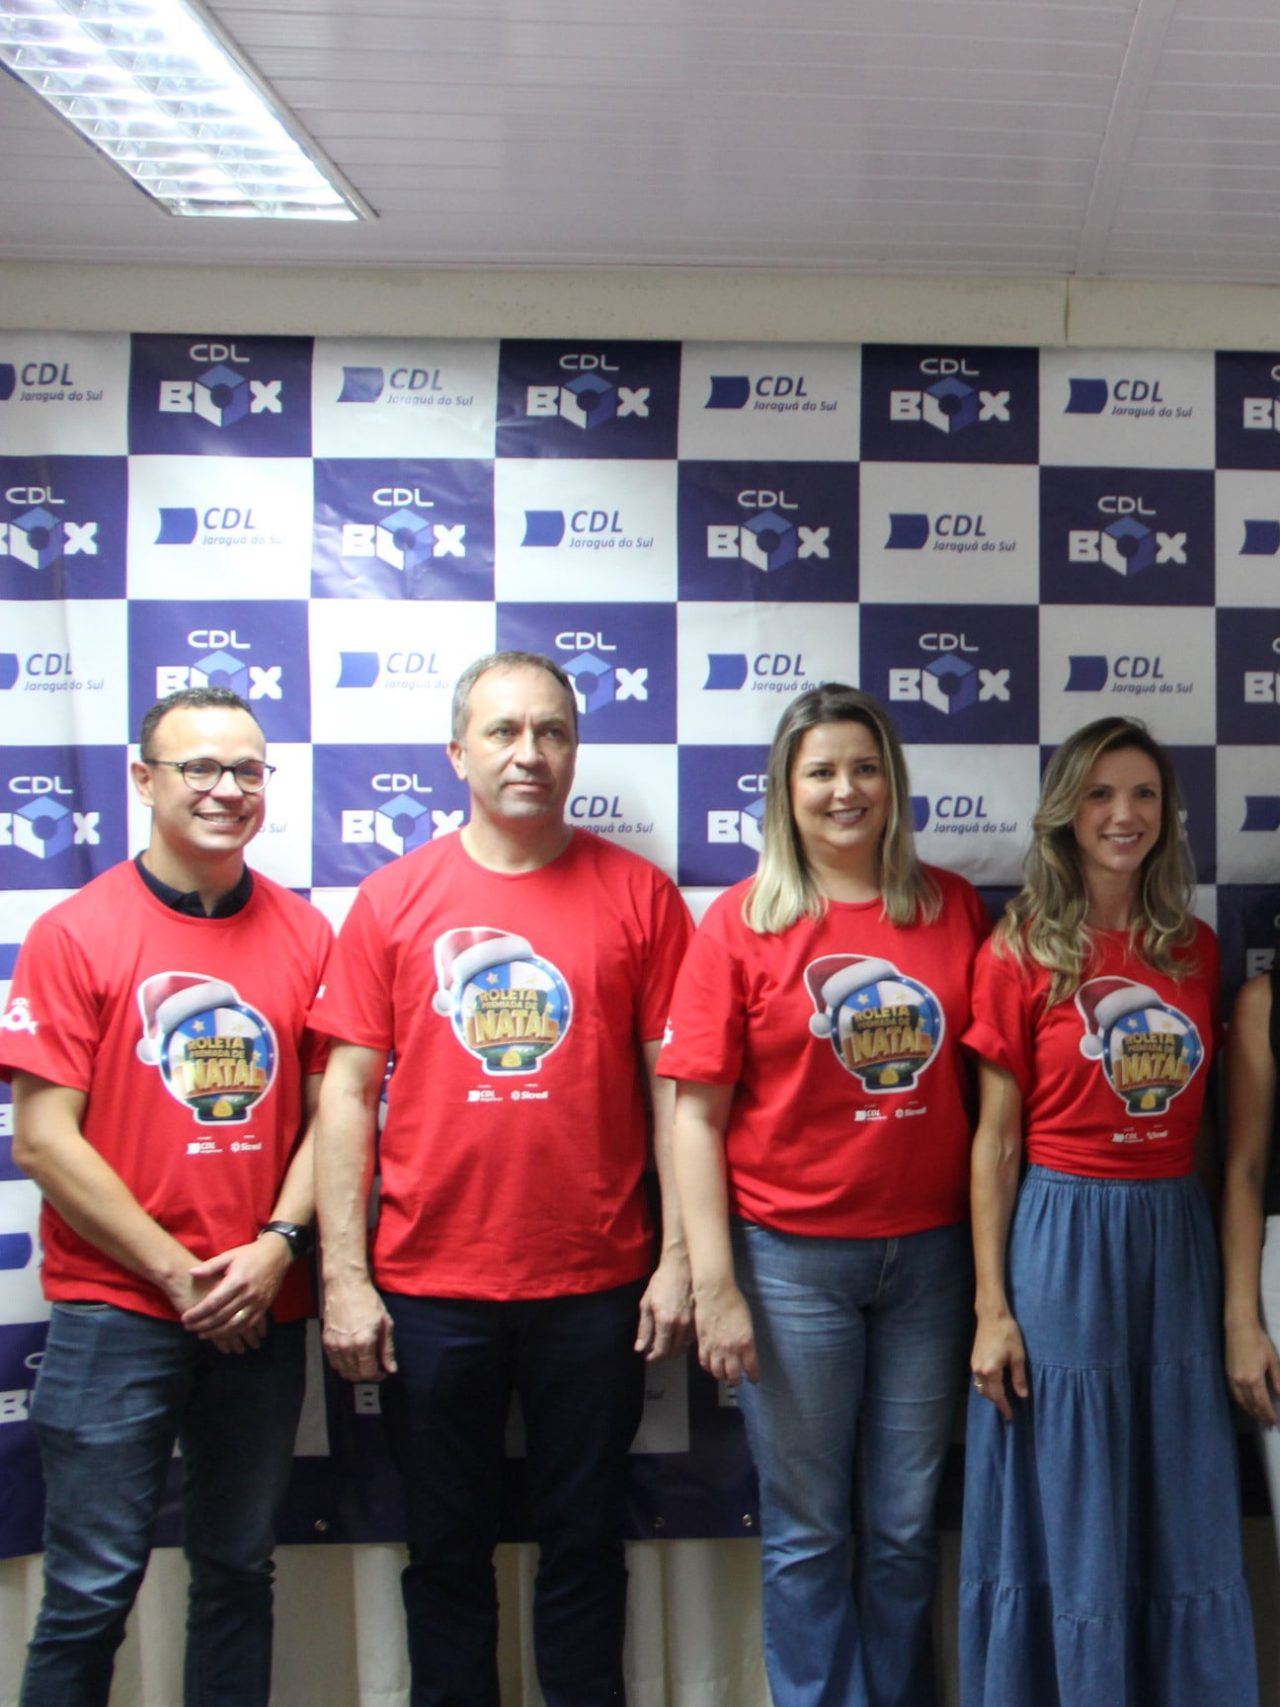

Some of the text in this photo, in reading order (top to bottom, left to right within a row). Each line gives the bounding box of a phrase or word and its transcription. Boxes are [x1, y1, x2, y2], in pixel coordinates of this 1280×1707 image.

[190, 344, 250, 362] CDL
[560, 354, 620, 370] CDL
[21, 363, 74, 386] CDL
[920, 359, 979, 375] CDL
[389, 369, 443, 391] CDL
[755, 376, 807, 397] CDL
[20, 391, 103, 402] Jaraguá do Sul
[159, 364, 282, 427] BOX
[437, 395, 452, 405] do
[456, 396, 473, 407] Sul
[526, 372, 650, 429] BOX
[1113, 380, 1163, 402] CDL
[754, 401, 837, 412] Jaraguá do Sul
[890, 375, 1010, 433] BOX
[1112, 406, 1192, 418] Jaraguá do Sul
[5, 487, 64, 504] CDL
[373, 488, 433, 507] CDL
[738, 490, 798, 508] CDL
[1098, 496, 1156, 514] CDL
[203, 508, 255, 529] CDL
[570, 510, 623, 532] CDL
[935, 515, 987, 537] CDL
[0, 506, 97, 570] OX
[342, 508, 465, 571] BOX
[570, 538, 654, 550] Jaraguá do Sul
[708, 510, 829, 572] BOX
[934, 540, 1015, 553] Jaraguá do Sul
[1069, 516, 1186, 576] BOX
[188, 630, 250, 648] CDL
[555, 632, 616, 650] CDL
[919, 633, 979, 651] CDL
[26, 654, 72, 675] CDL
[386, 652, 439, 674] CDL
[754, 654, 805, 675] CDL
[1114, 656, 1164, 678] CDL
[562, 652, 647, 715] OX
[752, 680, 797, 692] Jaraguá
[801, 681, 816, 691] do
[890, 653, 1010, 715] BOX
[1112, 683, 1192, 696] Jaraguá do Sul
[9, 776, 74, 794] CDL
[371, 774, 432, 792] CDL
[738, 775, 767, 792] CD
[570, 796, 623, 818] CDL
[936, 796, 987, 818] CDL
[617, 822, 653, 833] do Sul
[934, 822, 1016, 835] Jaraguá do Sul
[480, 990, 537, 1001] ROLETA
[853, 1005, 910, 1018] ROLETA
[475, 1009, 559, 1042] NATAL
[187, 1037, 244, 1050] ROLETA
[852, 1025, 931, 1062] NATAL
[182, 1058, 264, 1092] NATAL
[1122, 1053, 1189, 1085] NATAL
